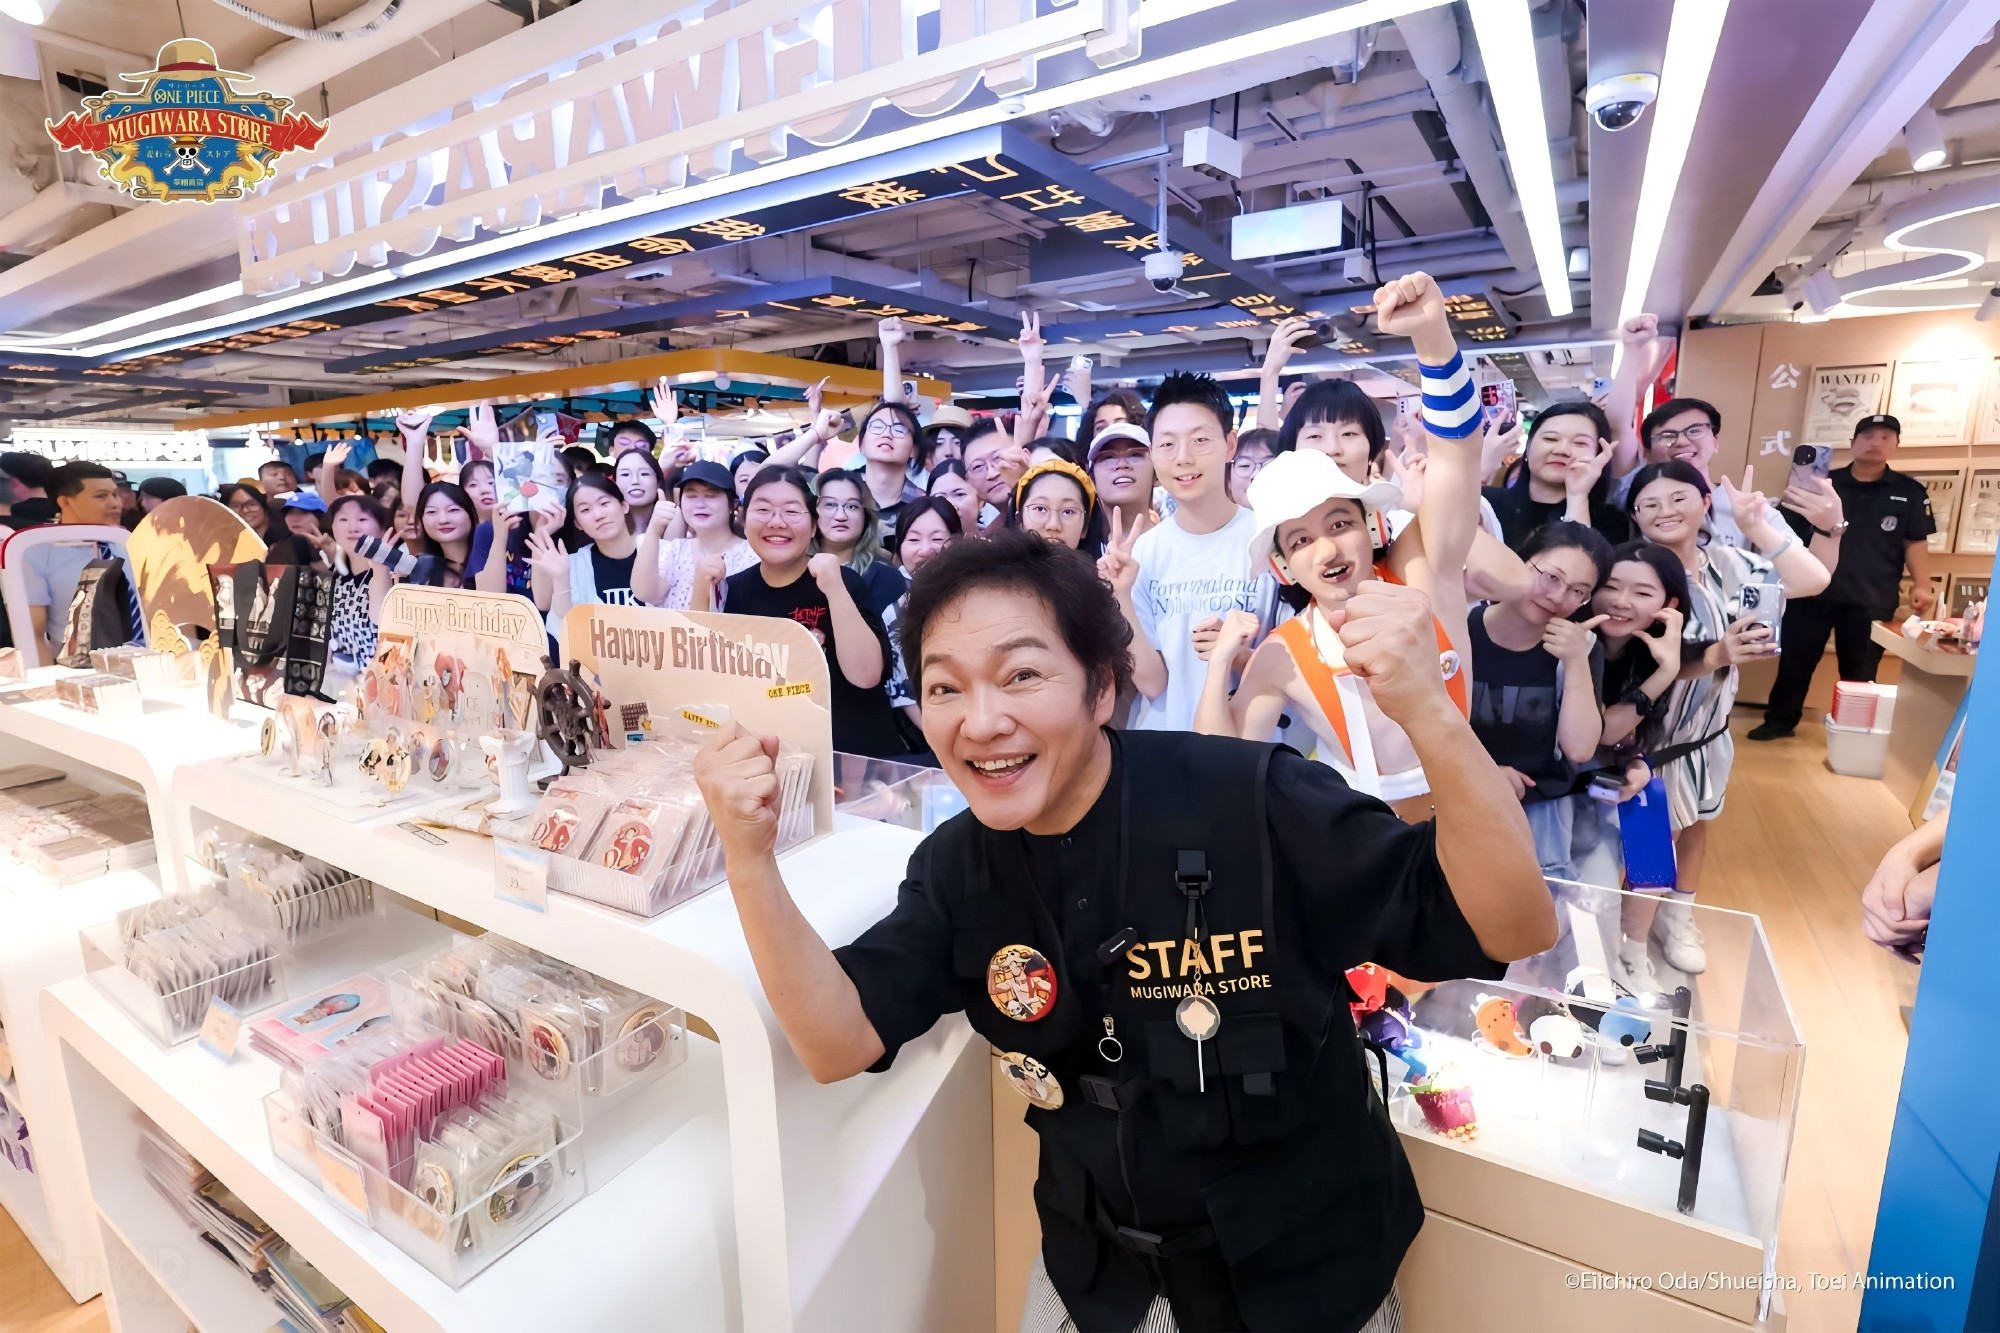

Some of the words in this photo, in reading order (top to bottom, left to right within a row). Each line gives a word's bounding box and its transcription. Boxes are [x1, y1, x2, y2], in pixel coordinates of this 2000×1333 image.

[395, 597, 444, 634] Happy
[447, 602, 525, 641] Birthday
[590, 618, 665, 671] Happy
[671, 627, 790, 686] Birthday
[768, 686, 784, 699] ONE
[786, 683, 812, 696] PIECE
[1126, 929, 1264, 980] STAFF
[1130, 981, 1216, 999] MUGIWARA
[1218, 974, 1273, 994] STORE
